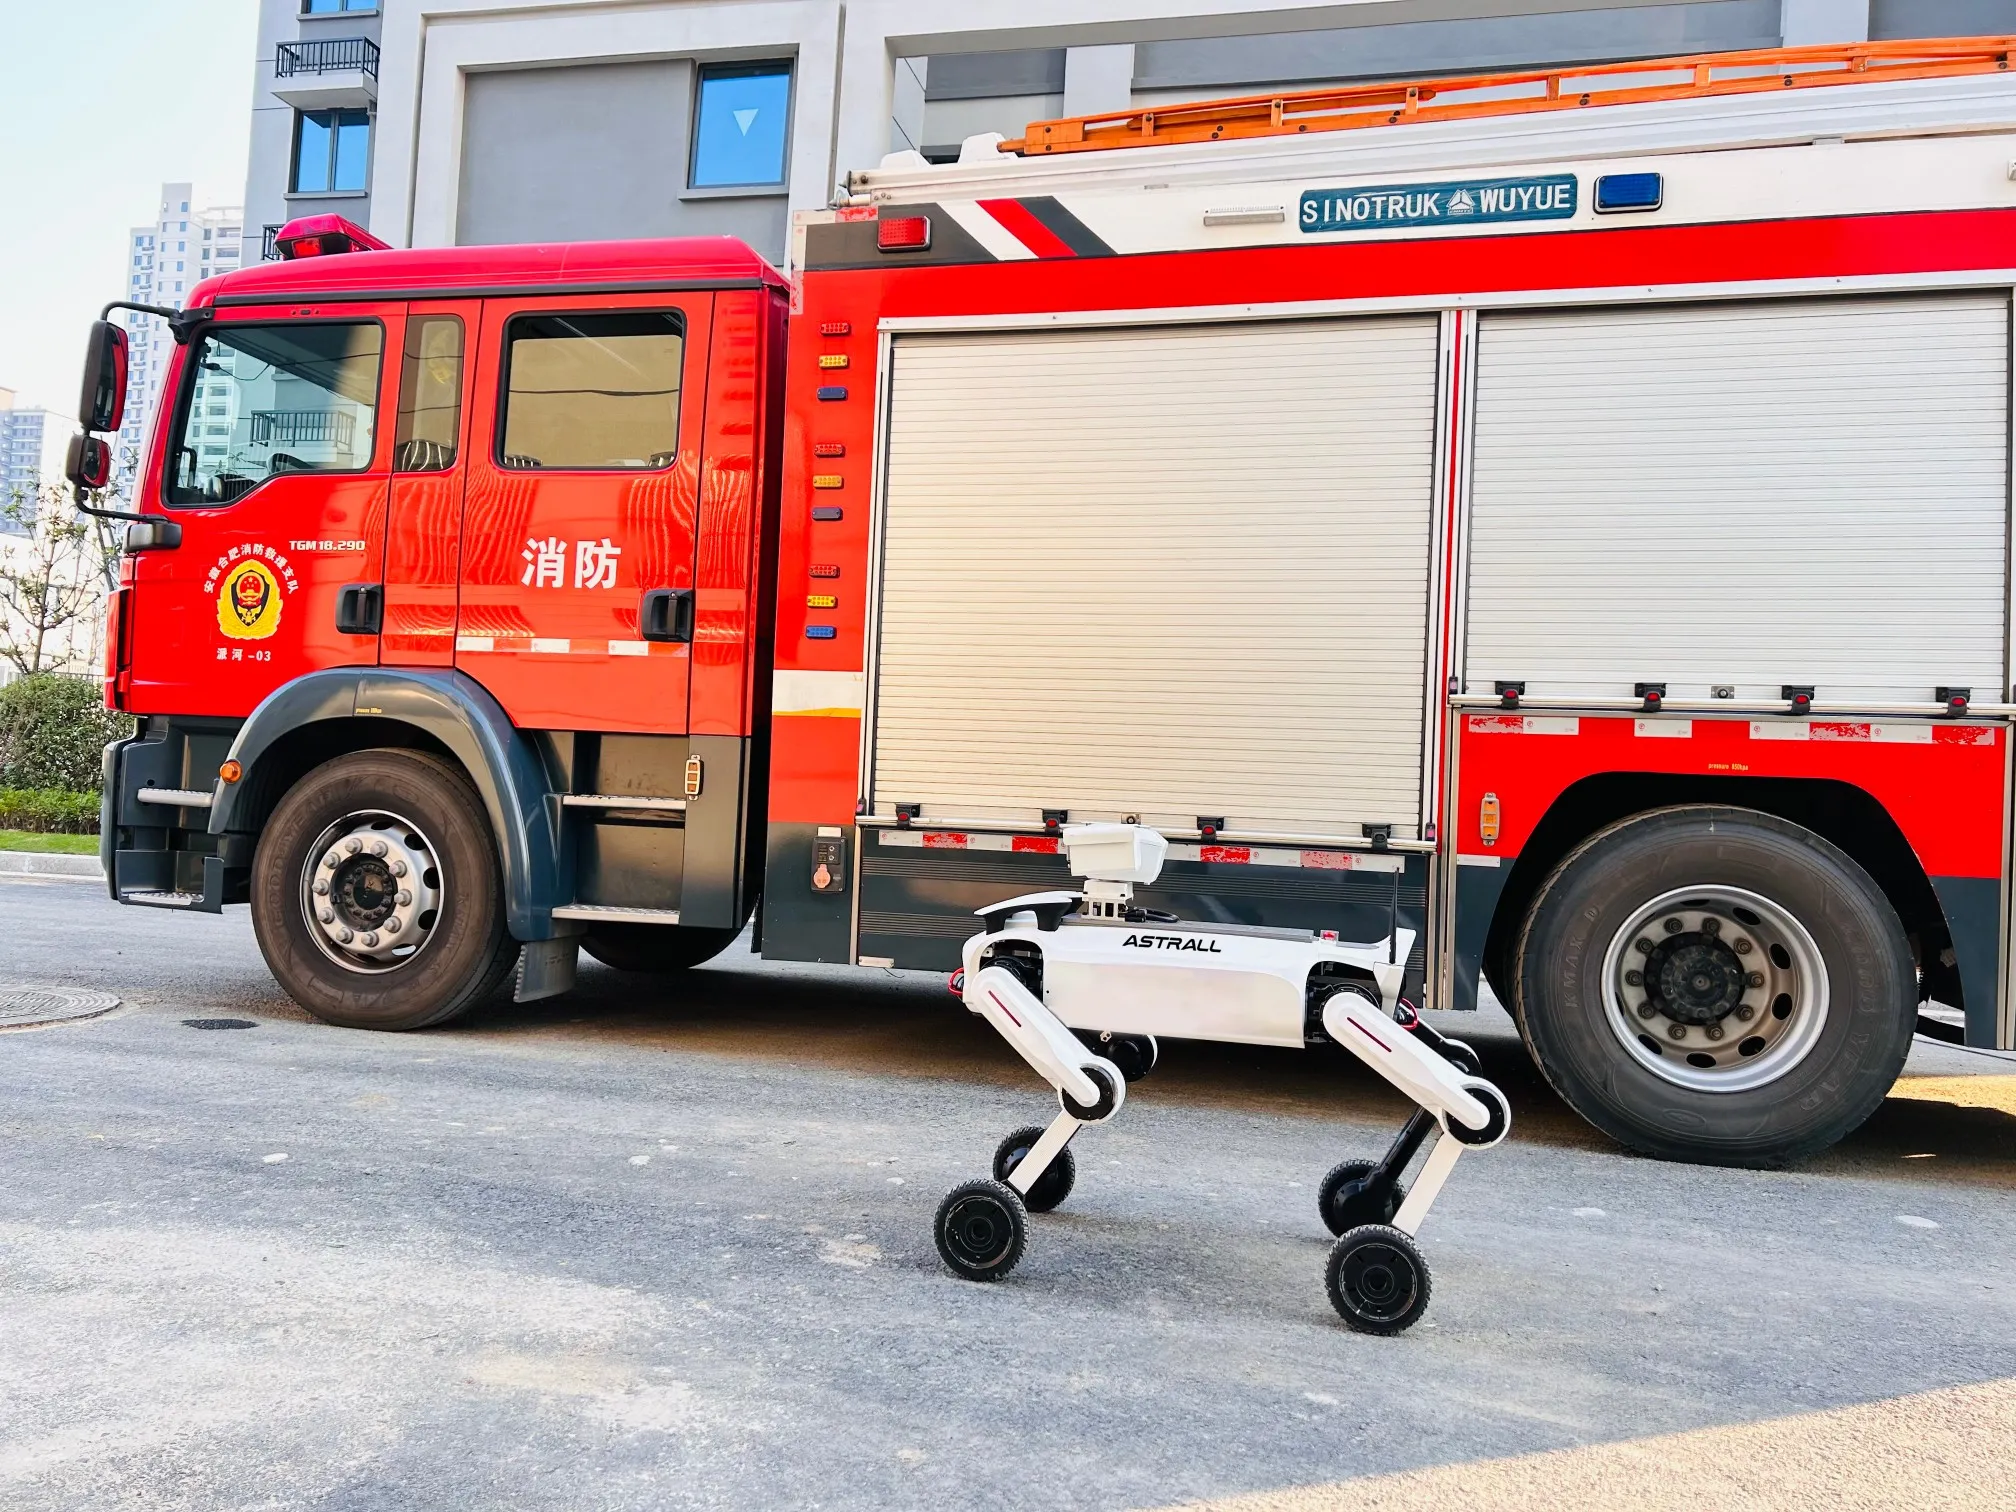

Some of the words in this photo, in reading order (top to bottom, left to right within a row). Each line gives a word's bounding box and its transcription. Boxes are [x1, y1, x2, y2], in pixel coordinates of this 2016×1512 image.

[1302, 192, 1440, 223] SINOTRUK
[1480, 184, 1571, 213] WUYUE
[289, 540, 316, 550] TGM
[318, 540, 366, 551] 18.290
[521, 536, 621, 589] 消防
[1122, 935, 1222, 953] ASTRALL
